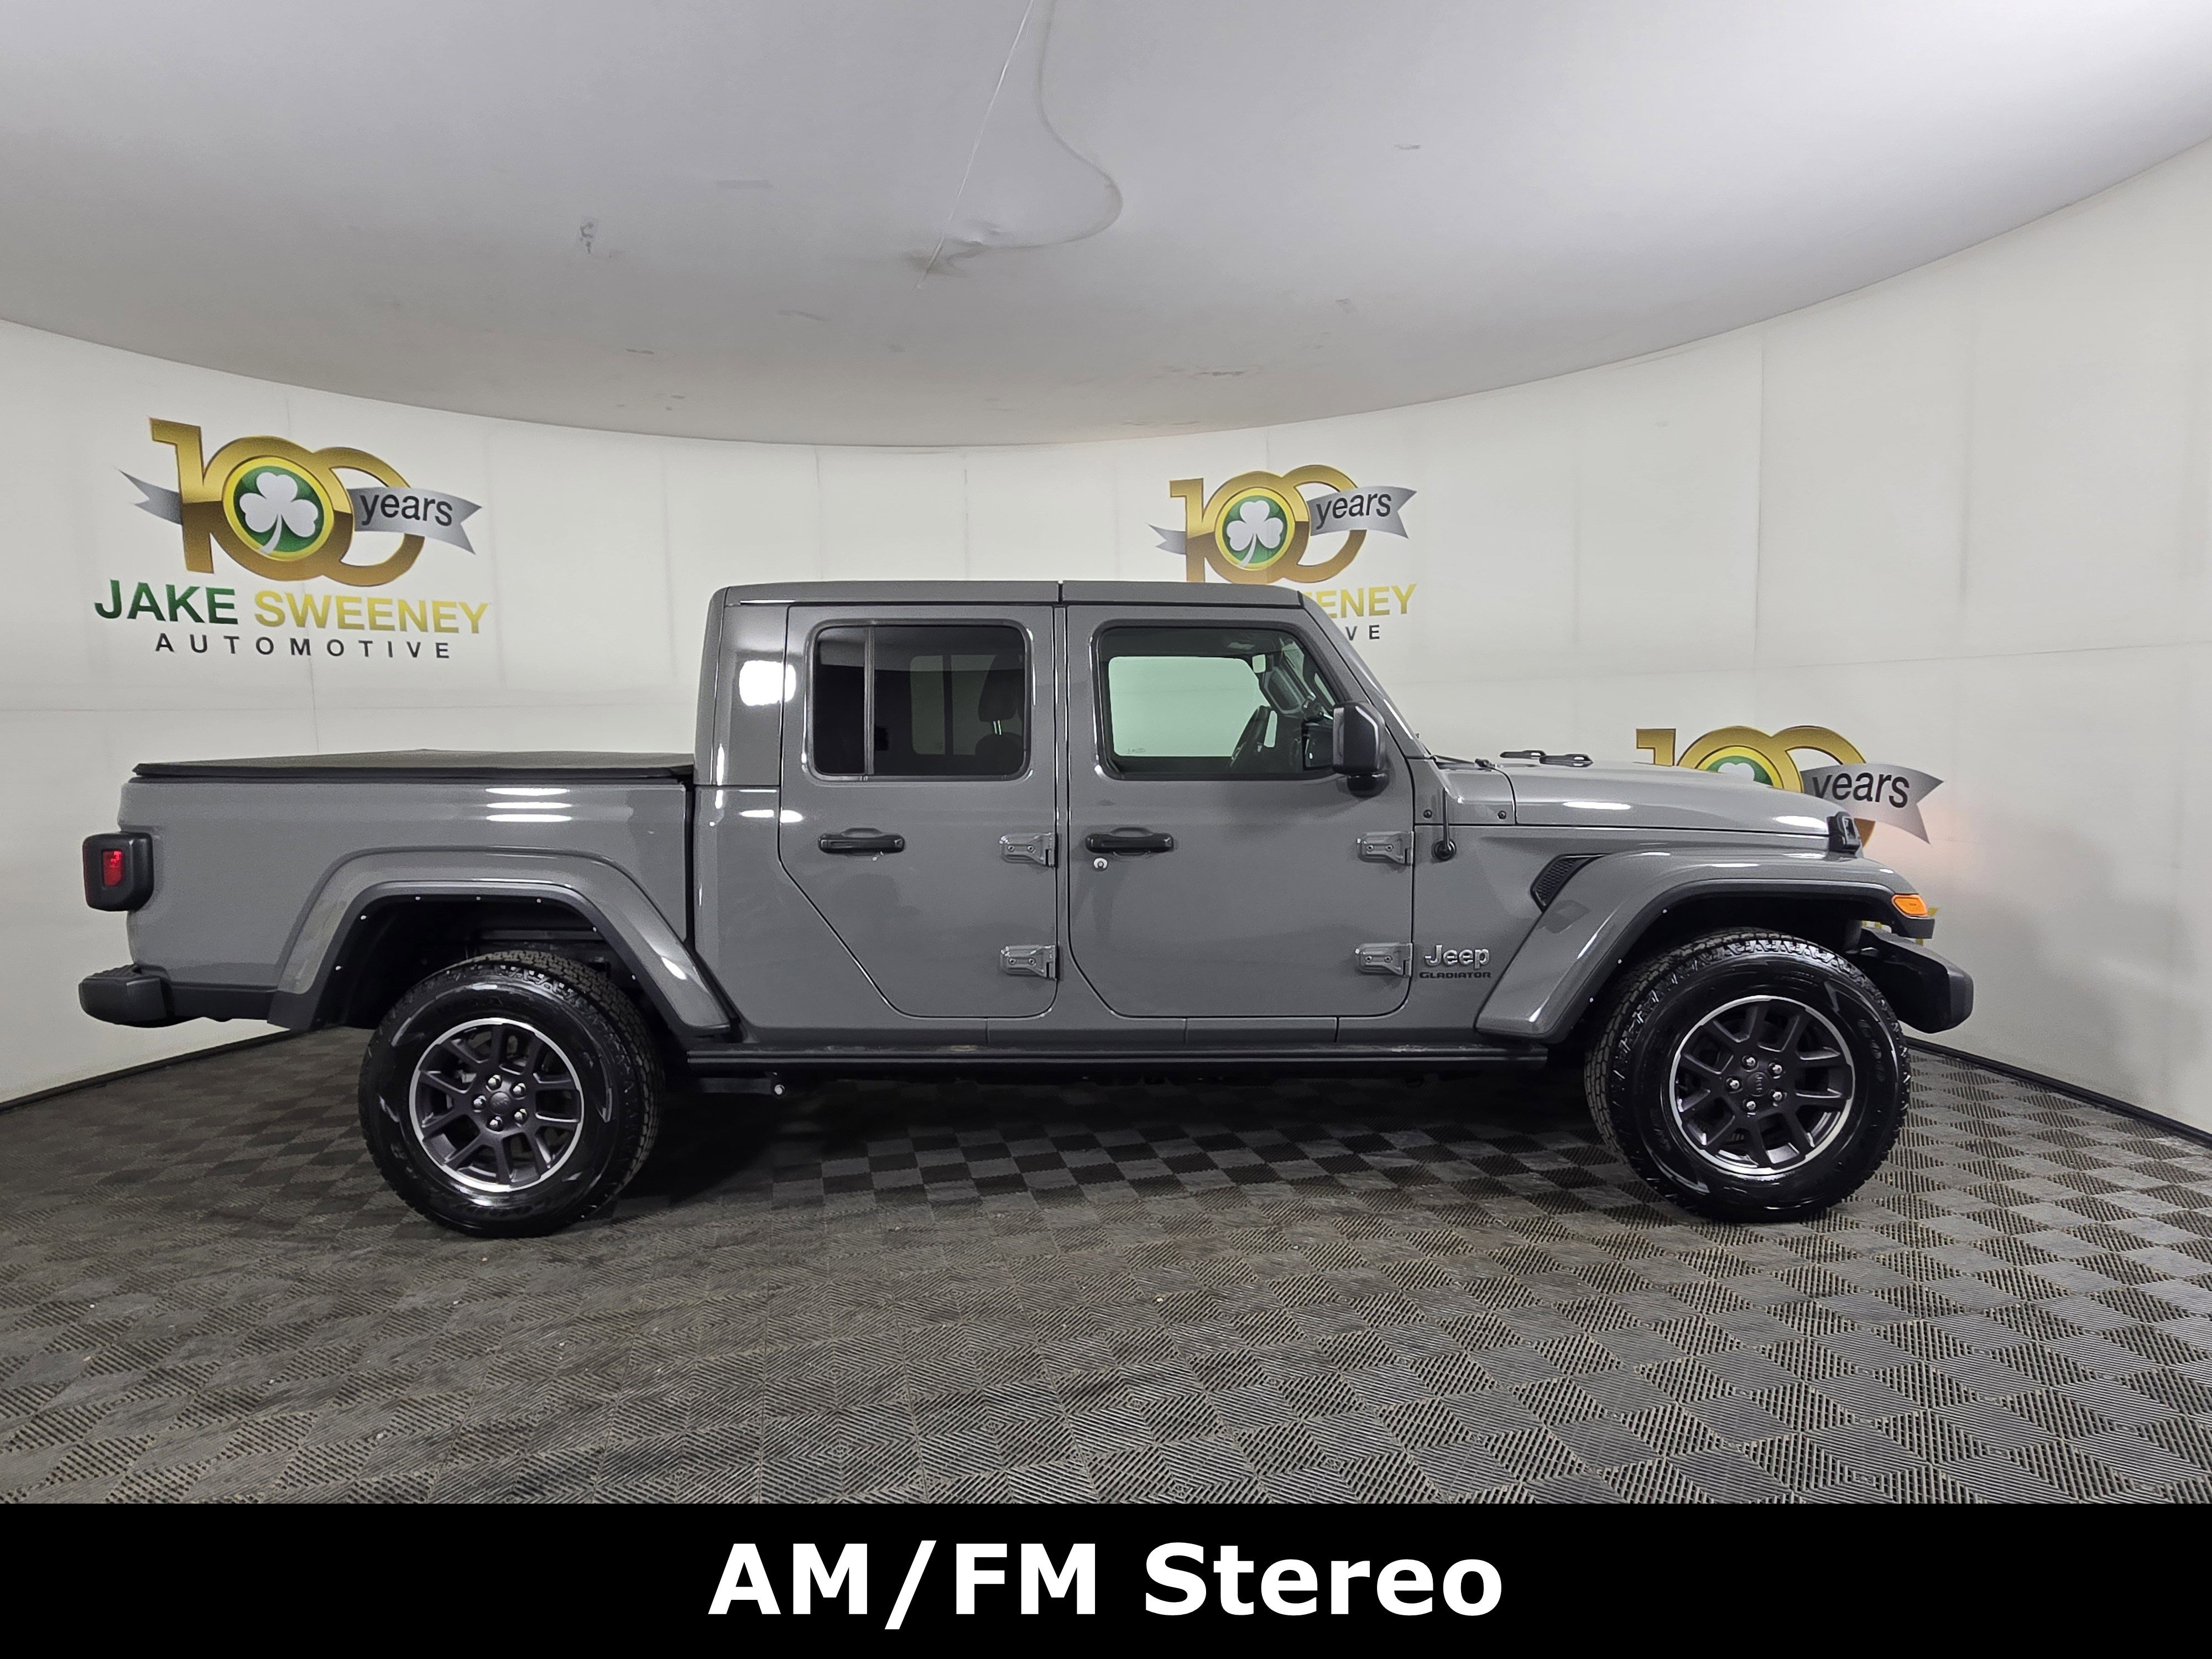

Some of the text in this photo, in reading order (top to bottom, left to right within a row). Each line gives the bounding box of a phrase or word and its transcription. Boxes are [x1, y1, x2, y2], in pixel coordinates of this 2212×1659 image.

[149, 418, 453, 587] 100 years
[1316, 492, 1392, 530] years
[95, 579, 489, 634] JAKE SWEENEY
[1303, 583, 1417, 619] ENEY
[155, 633, 450, 659] AUTOMOTIVE
[1812, 772, 1910, 808] years
[1425, 945, 1490, 969] Jeep
